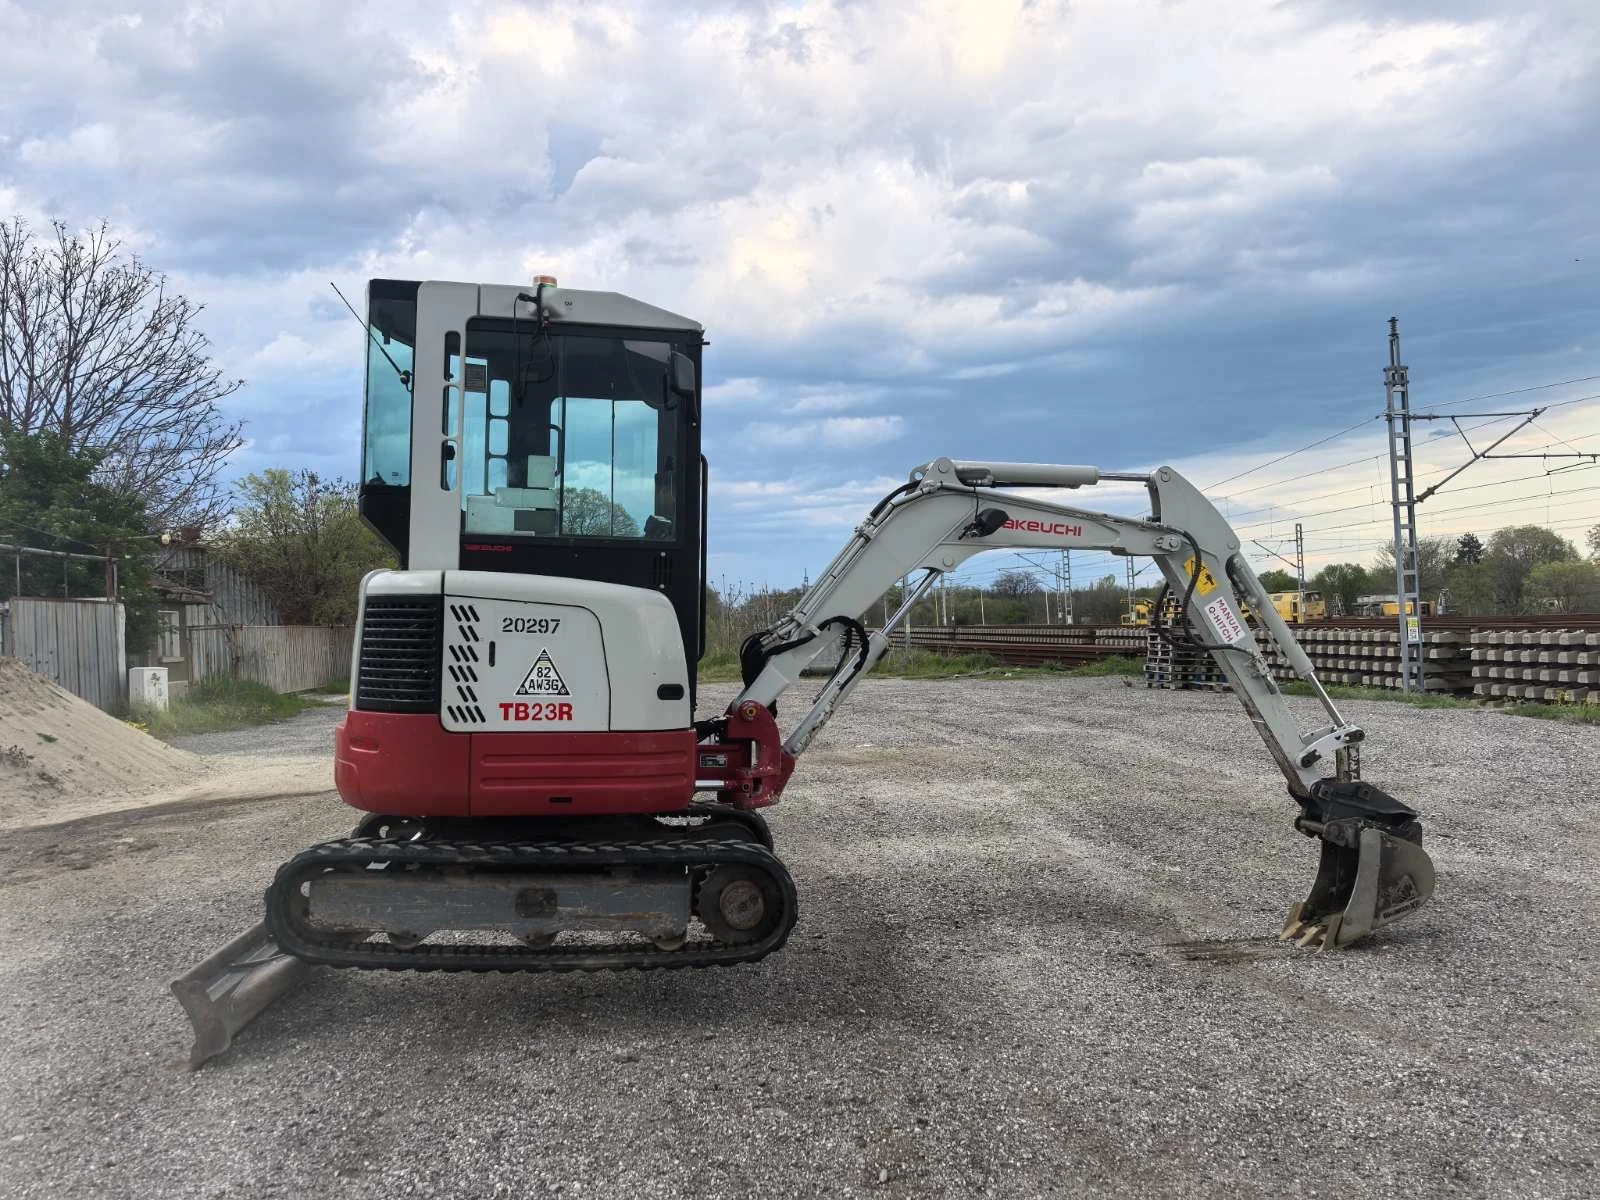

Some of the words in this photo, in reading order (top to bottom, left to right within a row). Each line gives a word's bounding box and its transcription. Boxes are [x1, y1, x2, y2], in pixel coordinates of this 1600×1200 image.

[502, 617, 561, 634] 20297
[1216, 599, 1241, 637] MANUAL
[536, 666, 552, 678] 82
[528, 678, 559, 691] AW3G
[498, 702, 573, 721] TB23R
